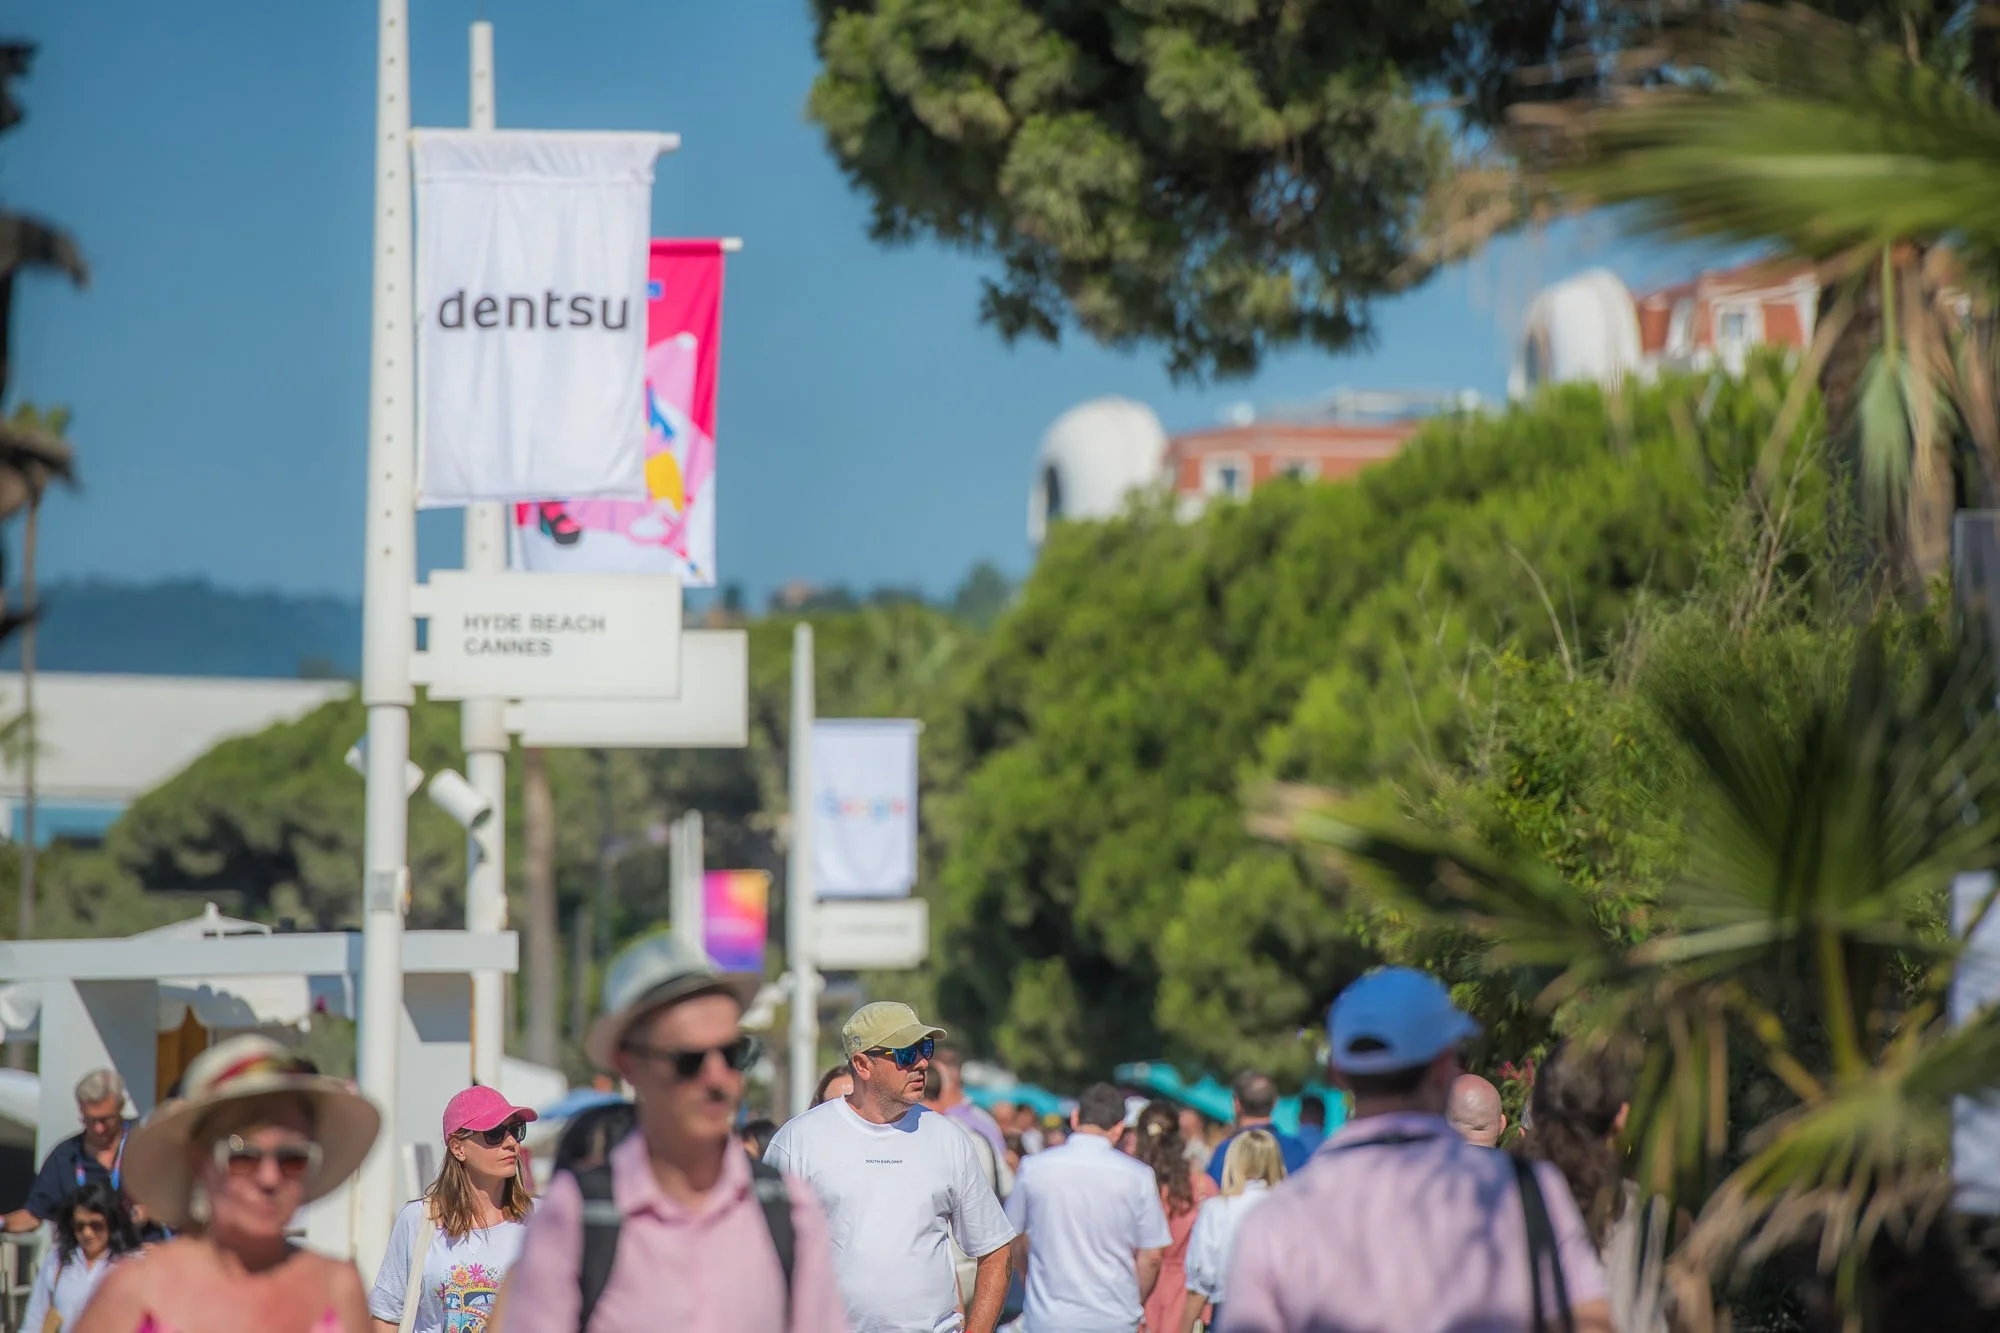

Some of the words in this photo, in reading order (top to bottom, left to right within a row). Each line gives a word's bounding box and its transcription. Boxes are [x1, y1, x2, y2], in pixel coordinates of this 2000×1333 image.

[438, 289, 628, 330] dentsu
[463, 613, 522, 632] HYDE
[529, 613, 606, 634] BEACH
[463, 636, 553, 657] CANNES
